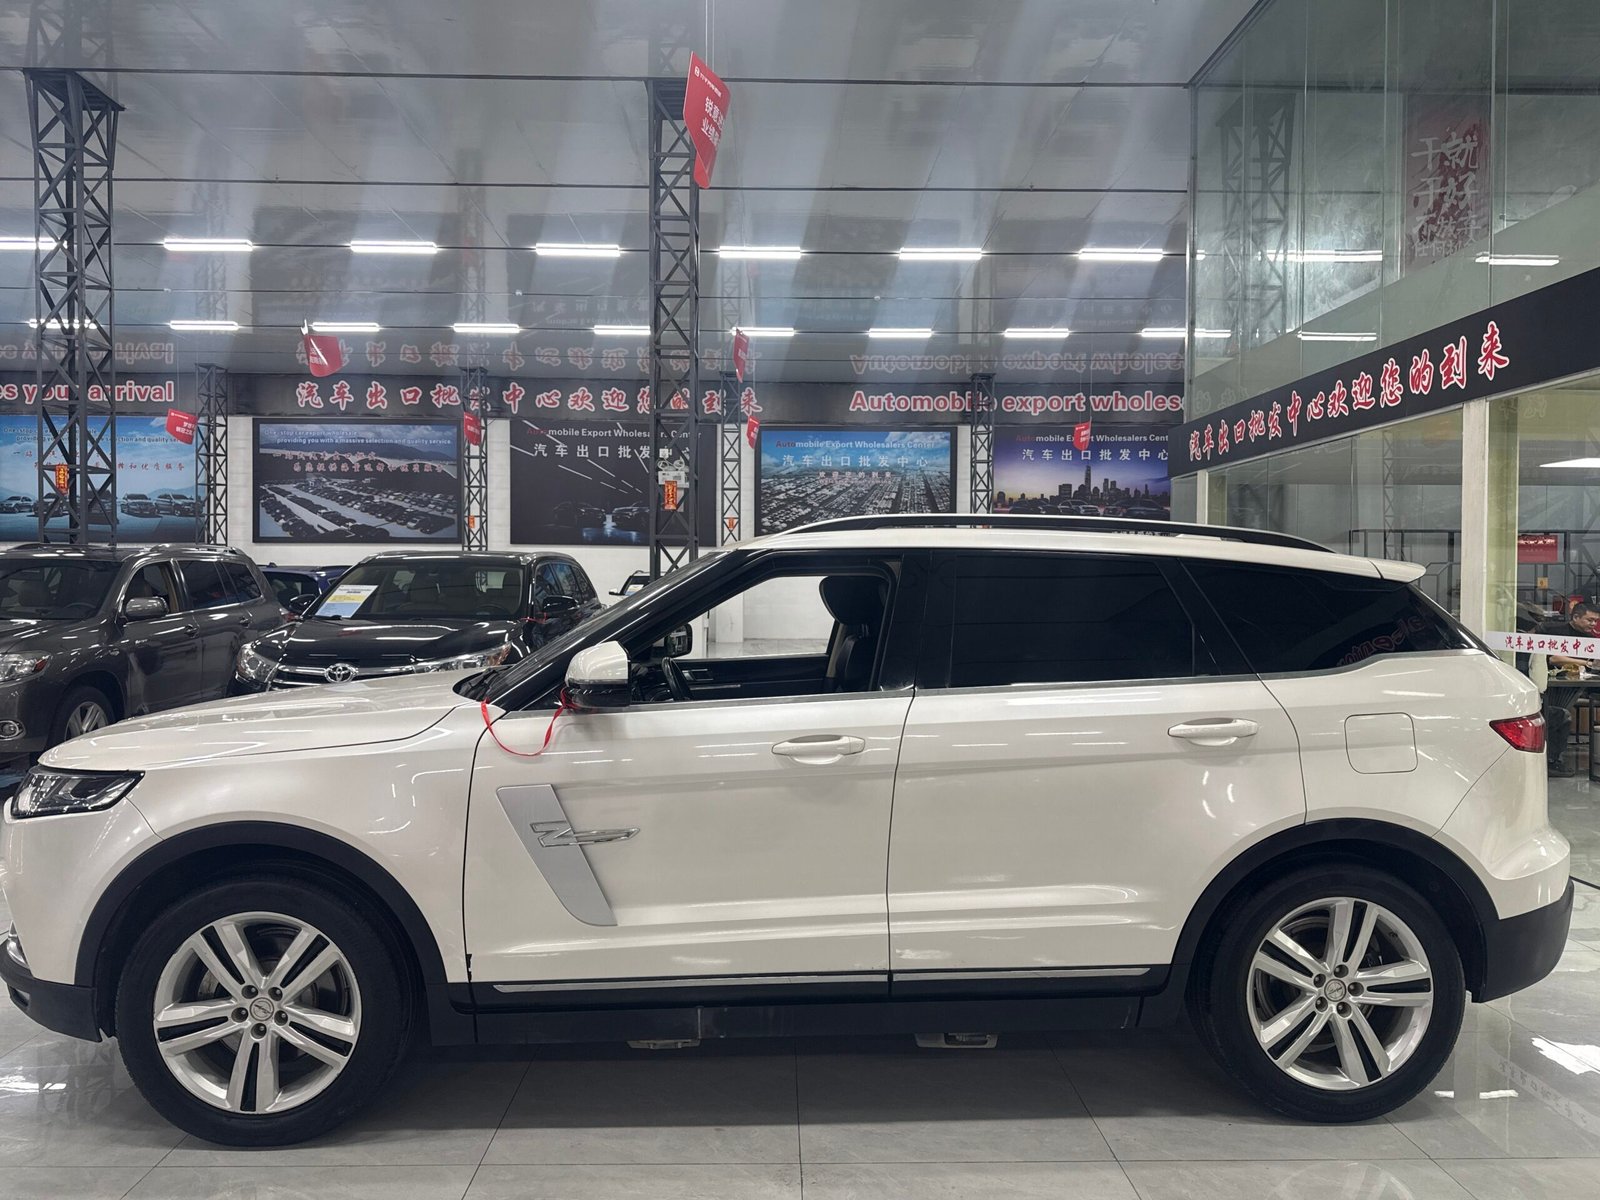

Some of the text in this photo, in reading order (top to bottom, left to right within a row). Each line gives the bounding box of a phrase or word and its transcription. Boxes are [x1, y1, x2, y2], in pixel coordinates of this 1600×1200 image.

[22, 384, 80, 404] you
[1189, 320, 1510, 461] 汽车出口批发中心欢迎您的到来
[1002, 393, 1086, 415] export
[1090, 391, 1184, 412] wholes
[582, 428, 611, 439] Export
[1096, 434, 1148, 442] Wholesalers
[1149, 433, 1168, 442] Cent
[776, 440, 824, 448] Automobile
[825, 440, 852, 450] Export
[855, 440, 906, 449] Wholesalers
[782, 454, 928, 468] 汽车出口批发中心
[1022, 448, 1168, 461] 汽车出口批发中心
[1505, 635, 1595, 655] 汽车出口批发中心
